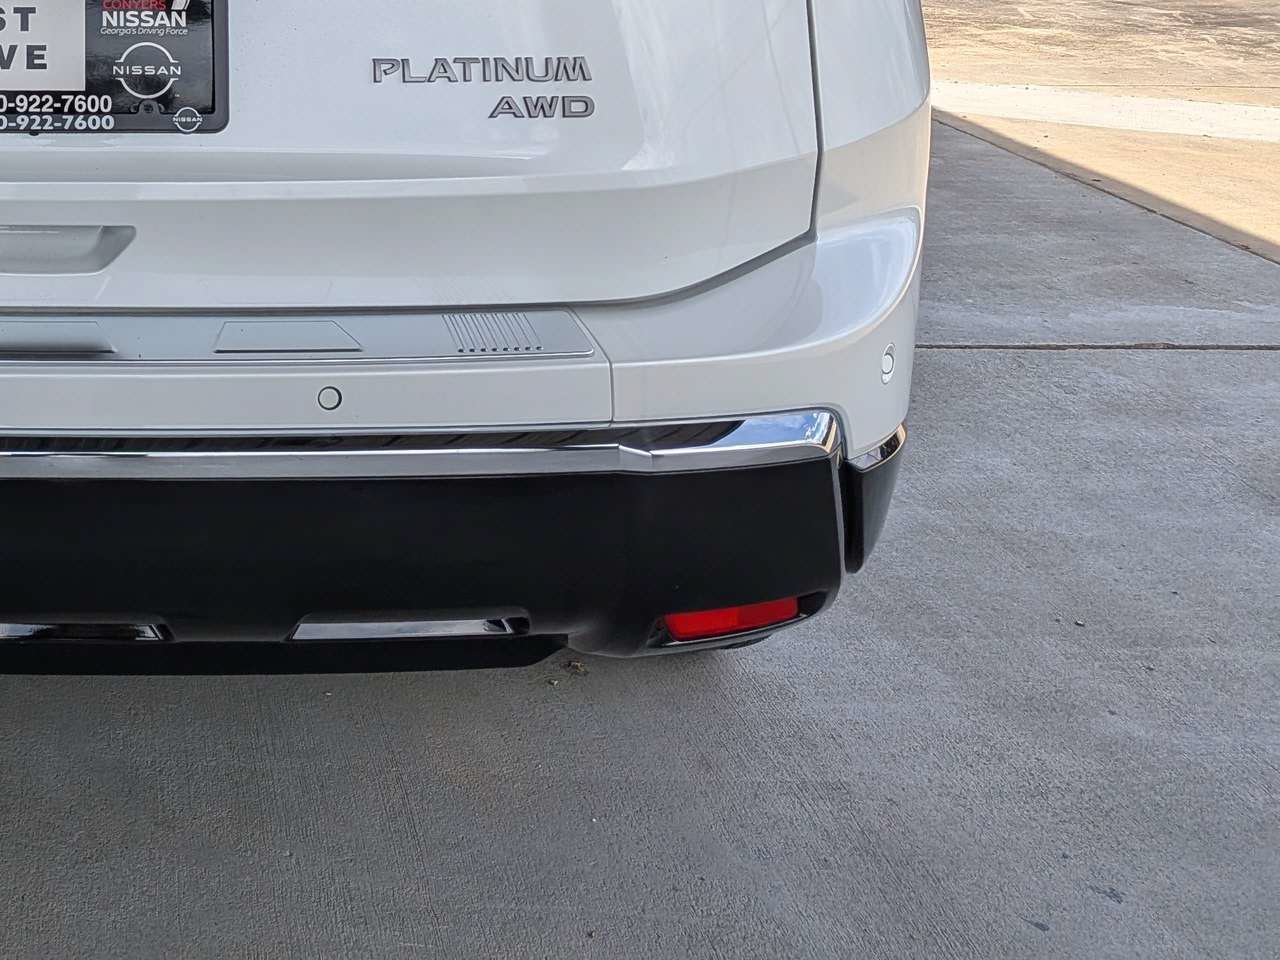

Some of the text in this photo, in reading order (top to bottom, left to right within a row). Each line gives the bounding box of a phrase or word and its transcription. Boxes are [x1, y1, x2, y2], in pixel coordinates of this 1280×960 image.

[102, 0, 167, 10] CONYERS
[102, 11, 187, 27] NISSAN
[100, 27, 189, 36] Georgia's Driving Force
[112, 65, 181, 75] NISSAN
[371, 56, 593, 83] PLATINUM
[488, 95, 596, 119] AWD
